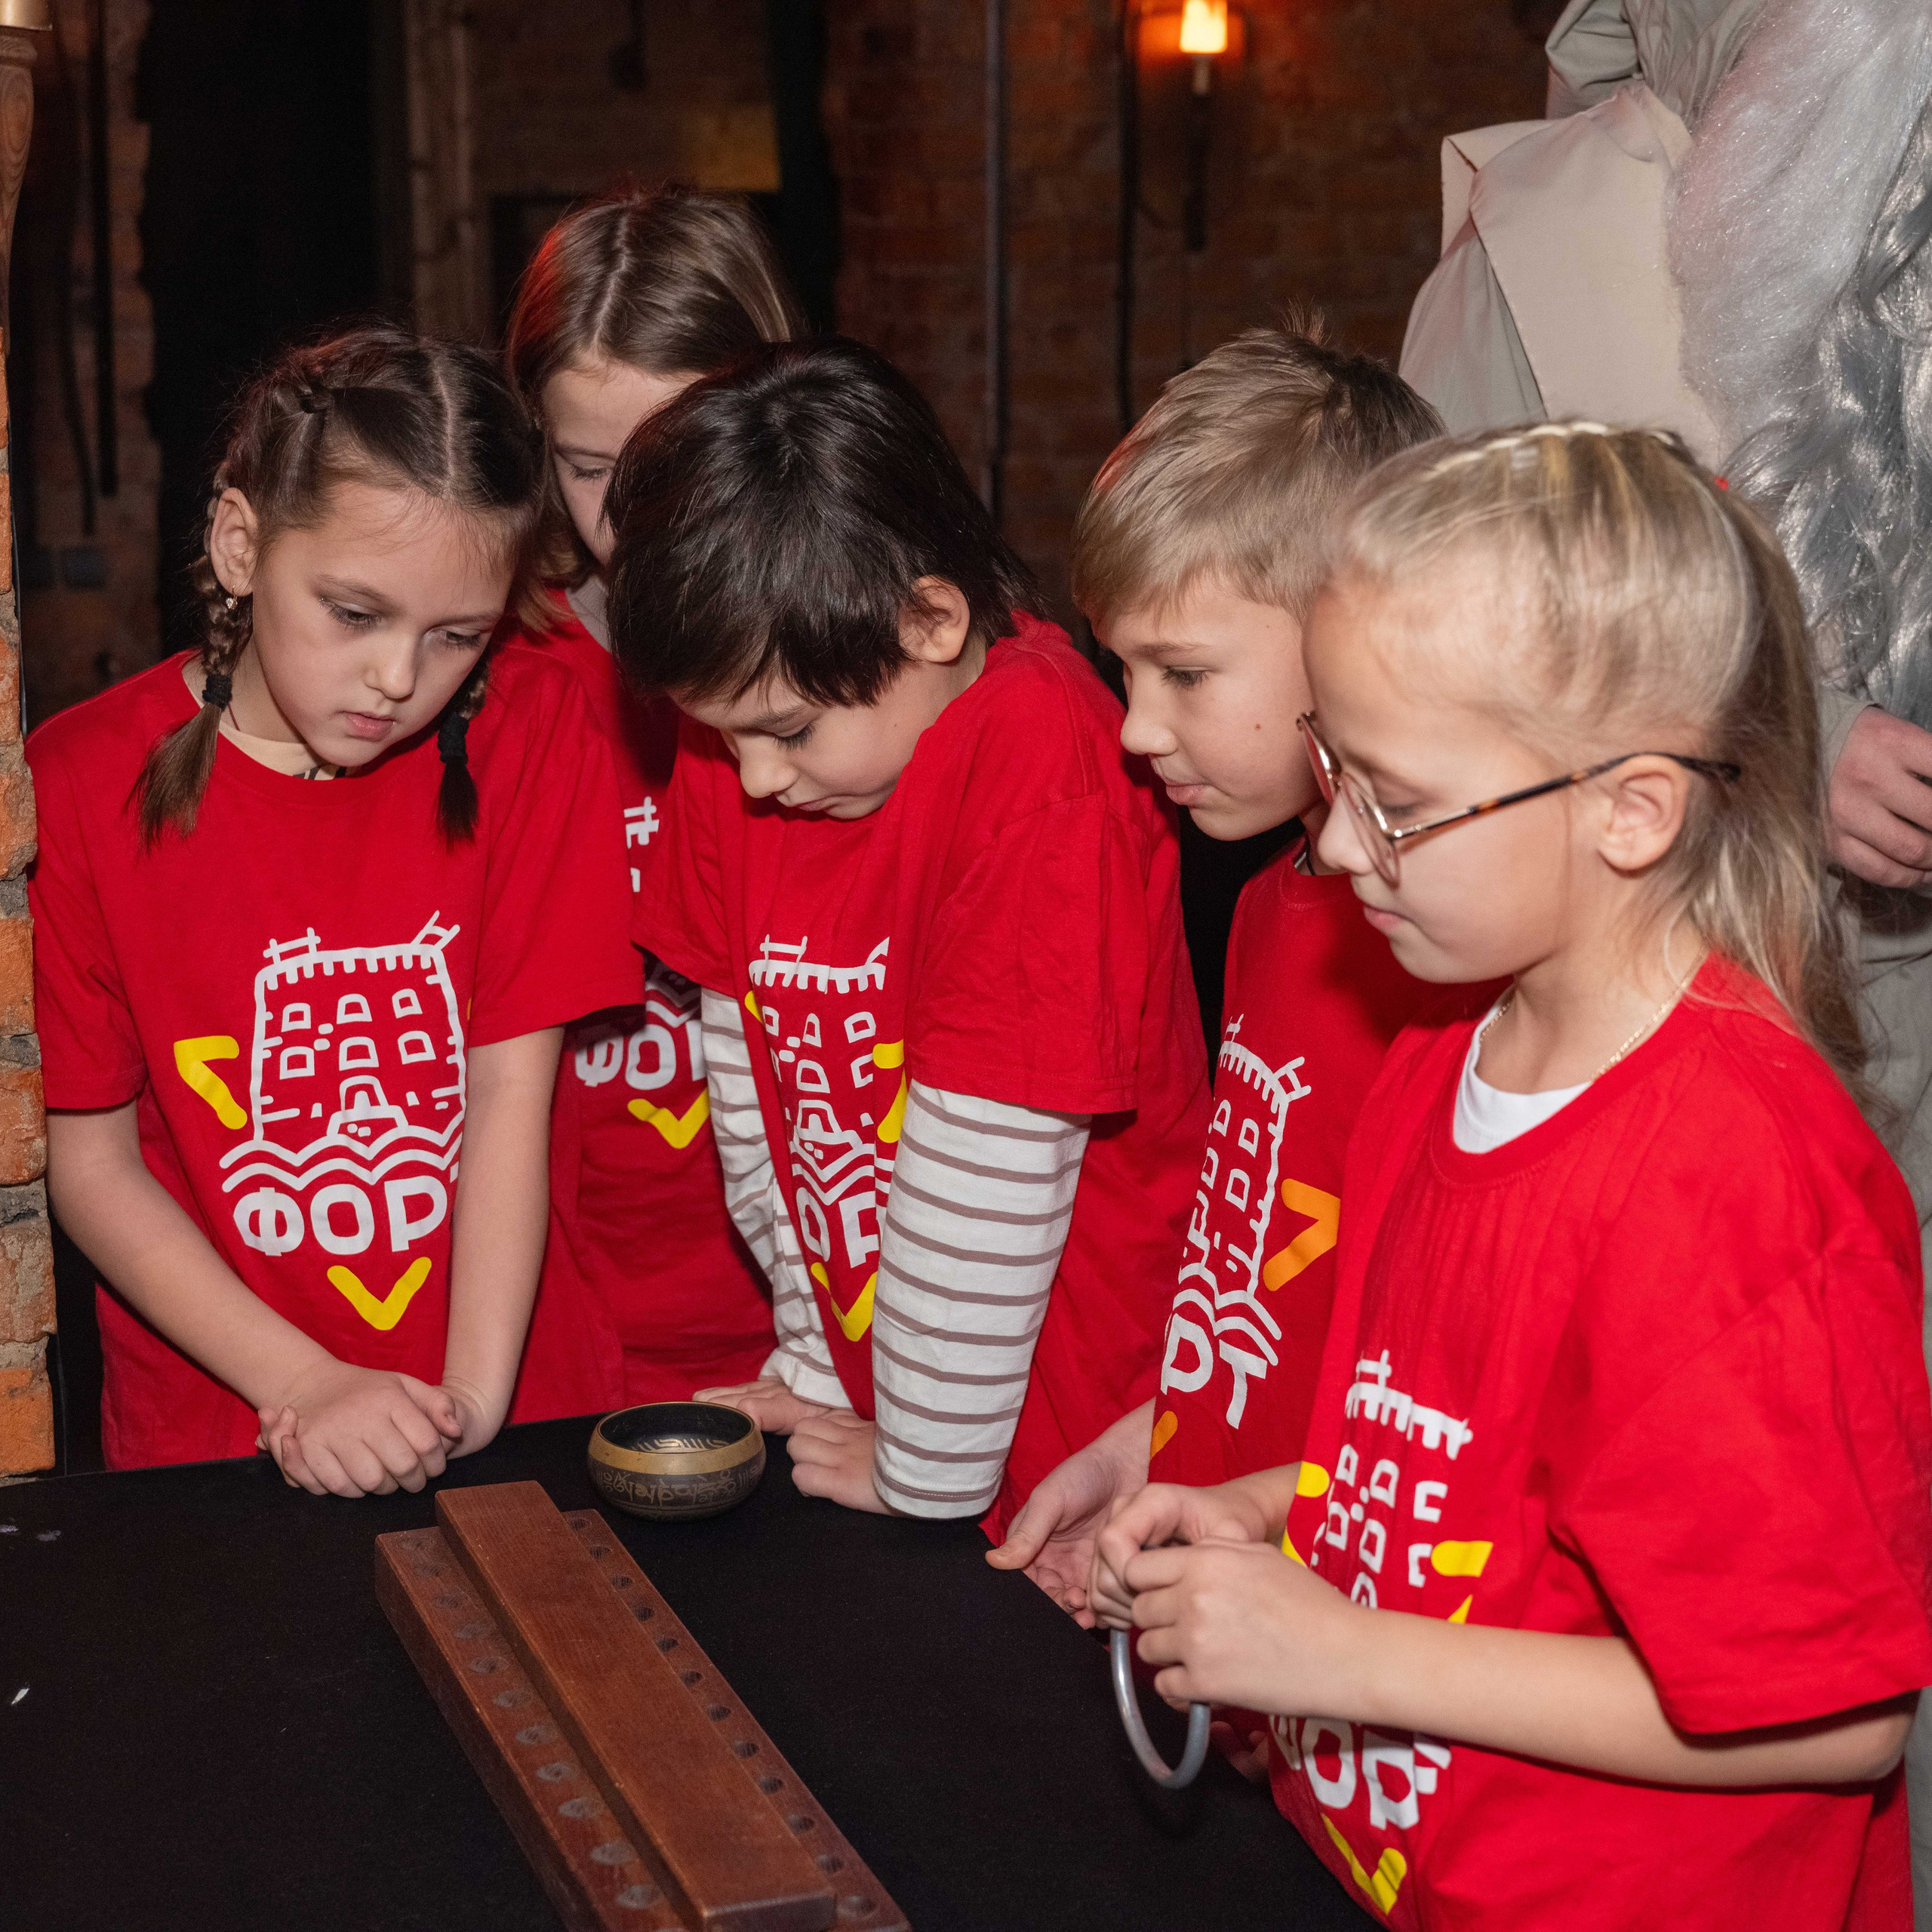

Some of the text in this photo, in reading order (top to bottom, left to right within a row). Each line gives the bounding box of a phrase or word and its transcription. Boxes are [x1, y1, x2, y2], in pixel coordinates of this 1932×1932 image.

[233, 1161, 459, 1257] ФОР
[796, 1186, 888, 1269] ОР
[1161, 1312, 1268, 1429] РТ
